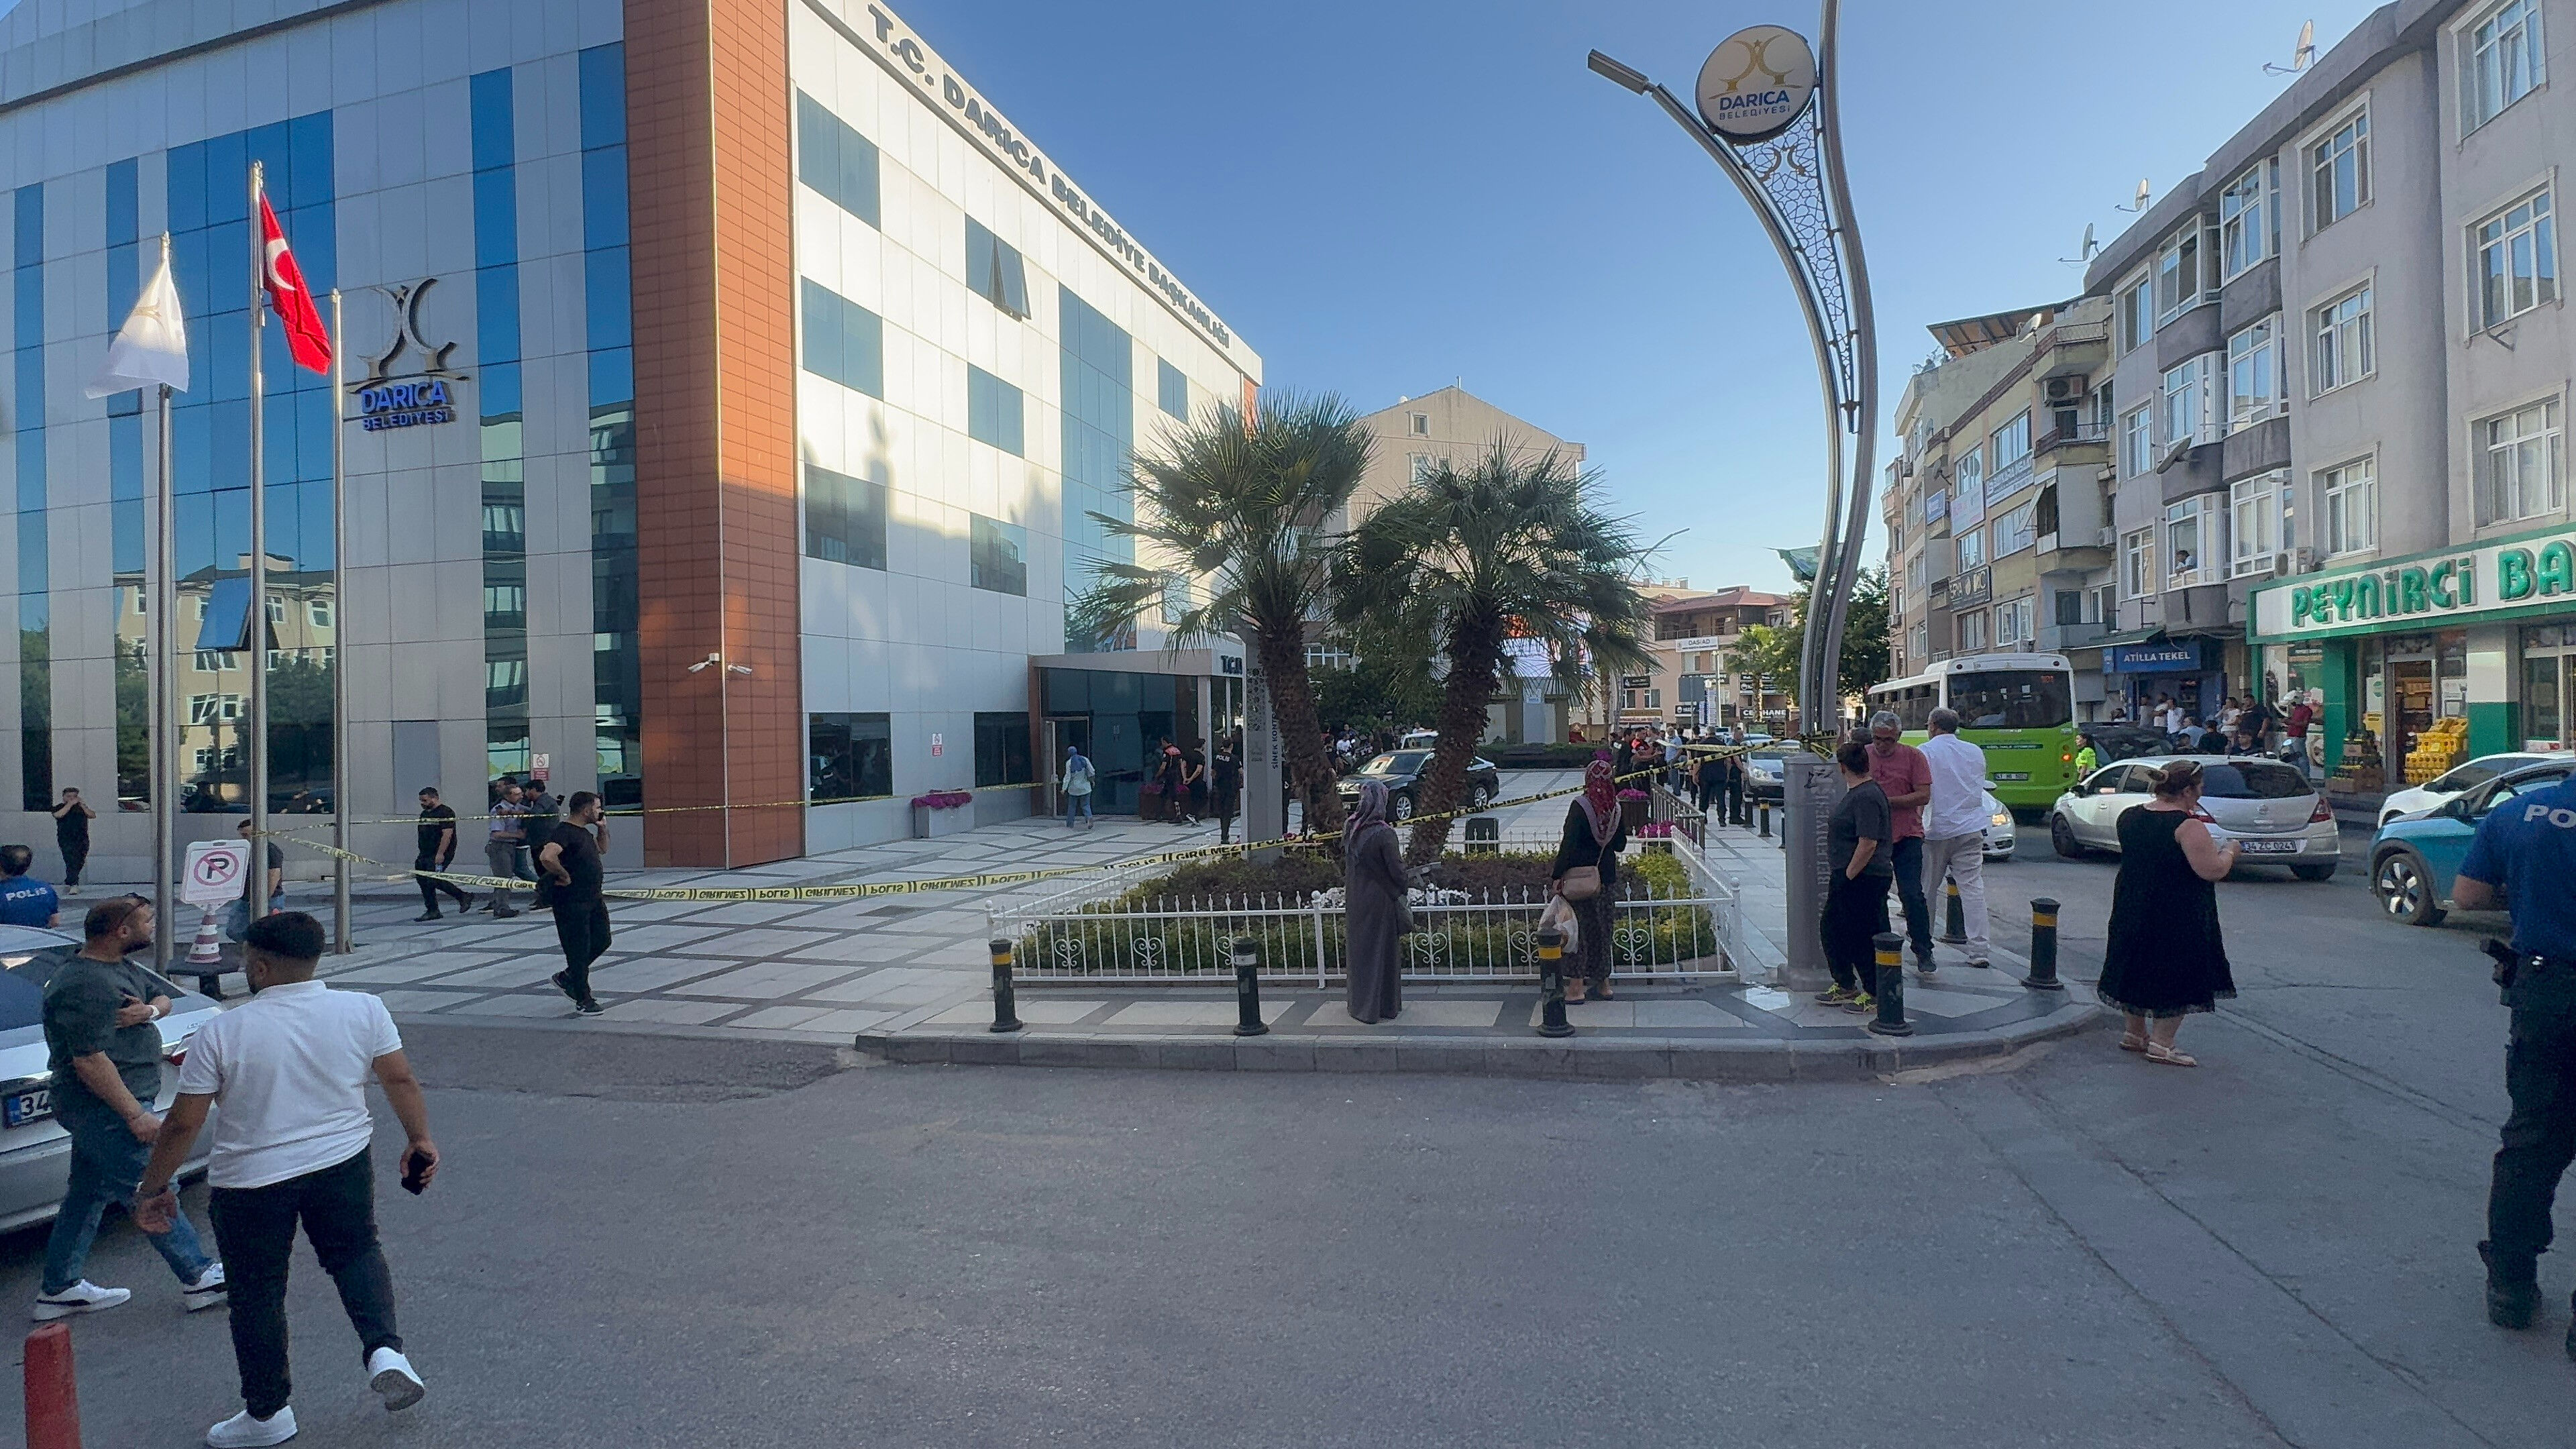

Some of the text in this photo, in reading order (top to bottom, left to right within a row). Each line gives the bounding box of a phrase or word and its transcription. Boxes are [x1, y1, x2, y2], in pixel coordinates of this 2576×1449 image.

[1719, 89, 1790, 111] DARICA
[868, 3, 1230, 349] T.C. DARICA BELEDİYE BAŞKANLIĞI
[361, 381, 449, 414] DARICA
[2124, 652, 2157, 662] ATİLLA
[2159, 651, 2191, 661] TEKEL
